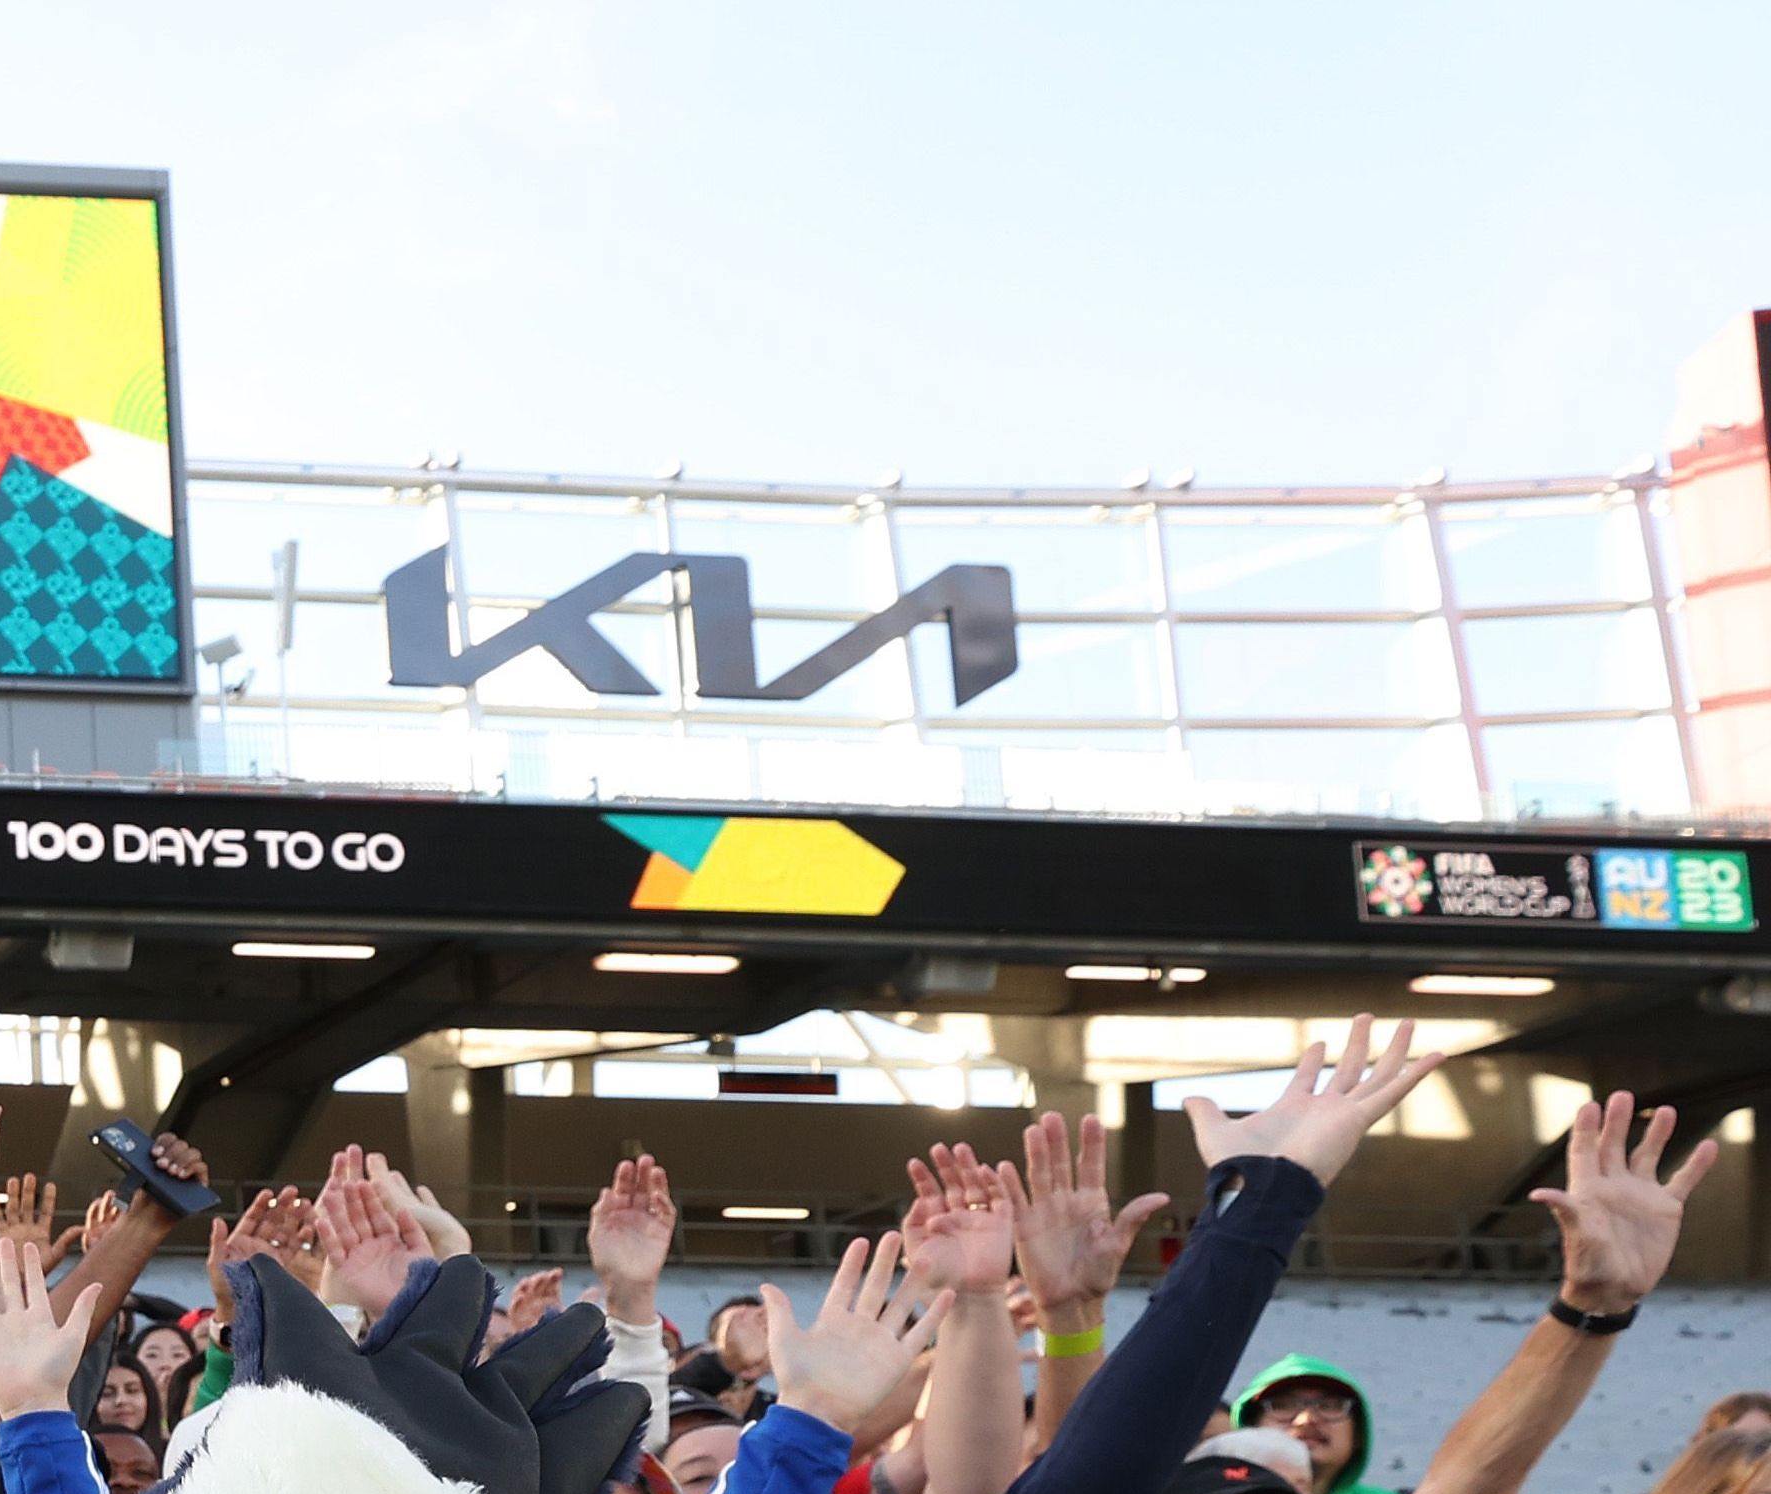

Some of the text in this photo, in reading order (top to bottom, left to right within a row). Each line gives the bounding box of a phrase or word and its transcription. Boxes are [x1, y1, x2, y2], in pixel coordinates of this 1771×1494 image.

[7, 820, 406, 873] 100 DAYS TO GO
[1605, 856, 1669, 889] AU
[1676, 859, 1741, 891] 20
[1609, 890, 1671, 920] NZ
[1681, 891, 1745, 922] 23
